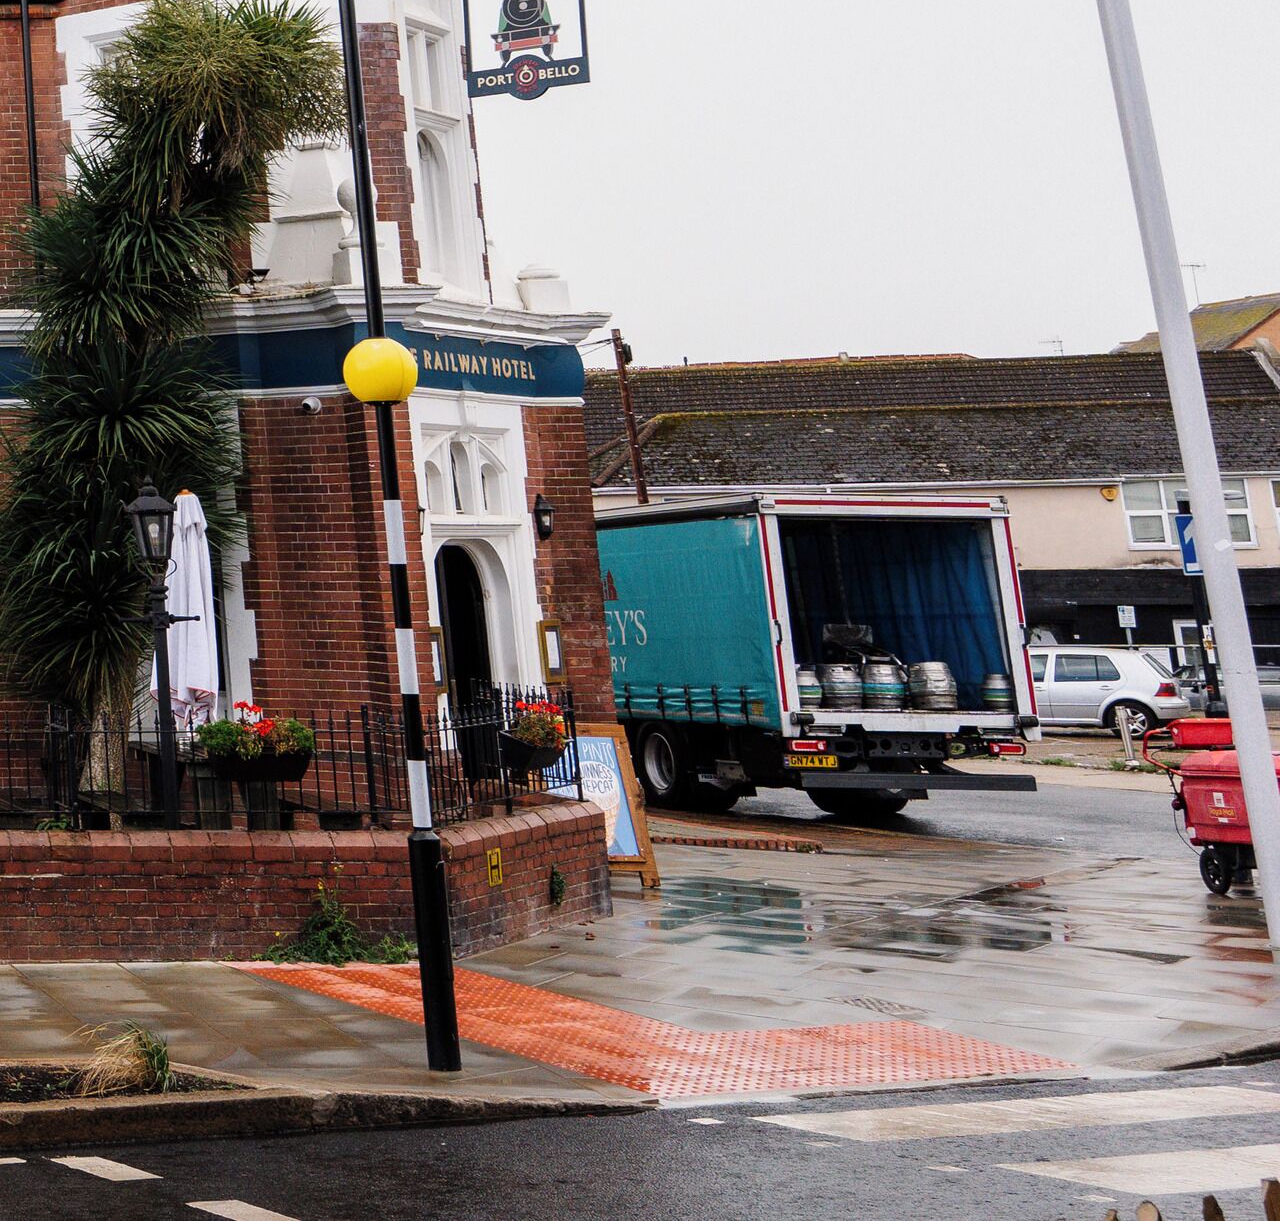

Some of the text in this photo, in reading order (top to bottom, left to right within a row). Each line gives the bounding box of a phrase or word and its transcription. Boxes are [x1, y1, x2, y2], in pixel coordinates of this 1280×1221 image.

[423, 349, 488, 376] RAILWAY
[491, 357, 536, 381] HOTEL
[604, 609, 647, 646] EY'S
[582, 742, 615, 768] PINTS
[580, 764, 613, 780] UINNESS
